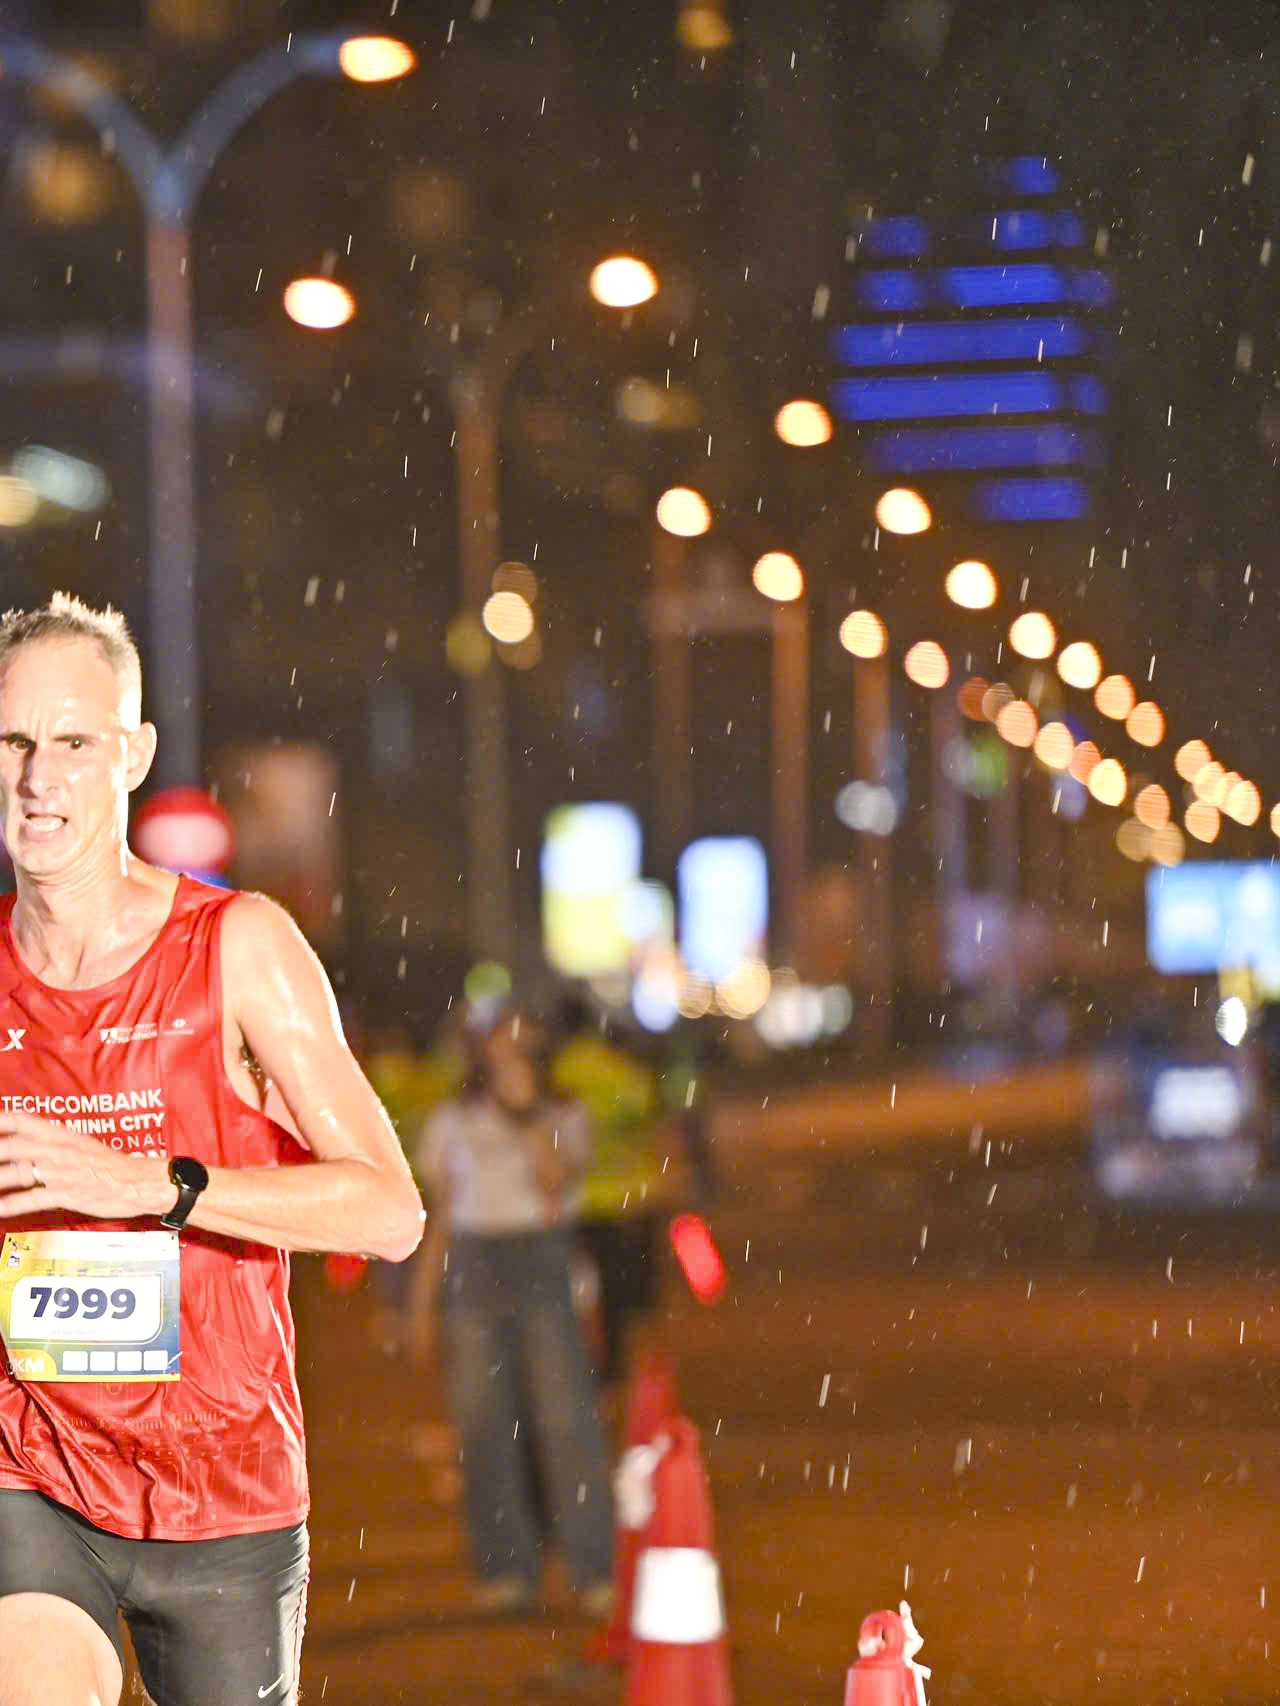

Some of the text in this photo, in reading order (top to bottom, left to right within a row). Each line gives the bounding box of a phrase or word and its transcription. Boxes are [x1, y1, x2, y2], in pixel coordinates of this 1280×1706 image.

[1, 1088, 164, 1114] TECHCOMBANK
[65, 1117, 116, 1134] MINH
[119, 1112, 165, 1131] CITY
[29, 1286, 137, 1320] 7999
